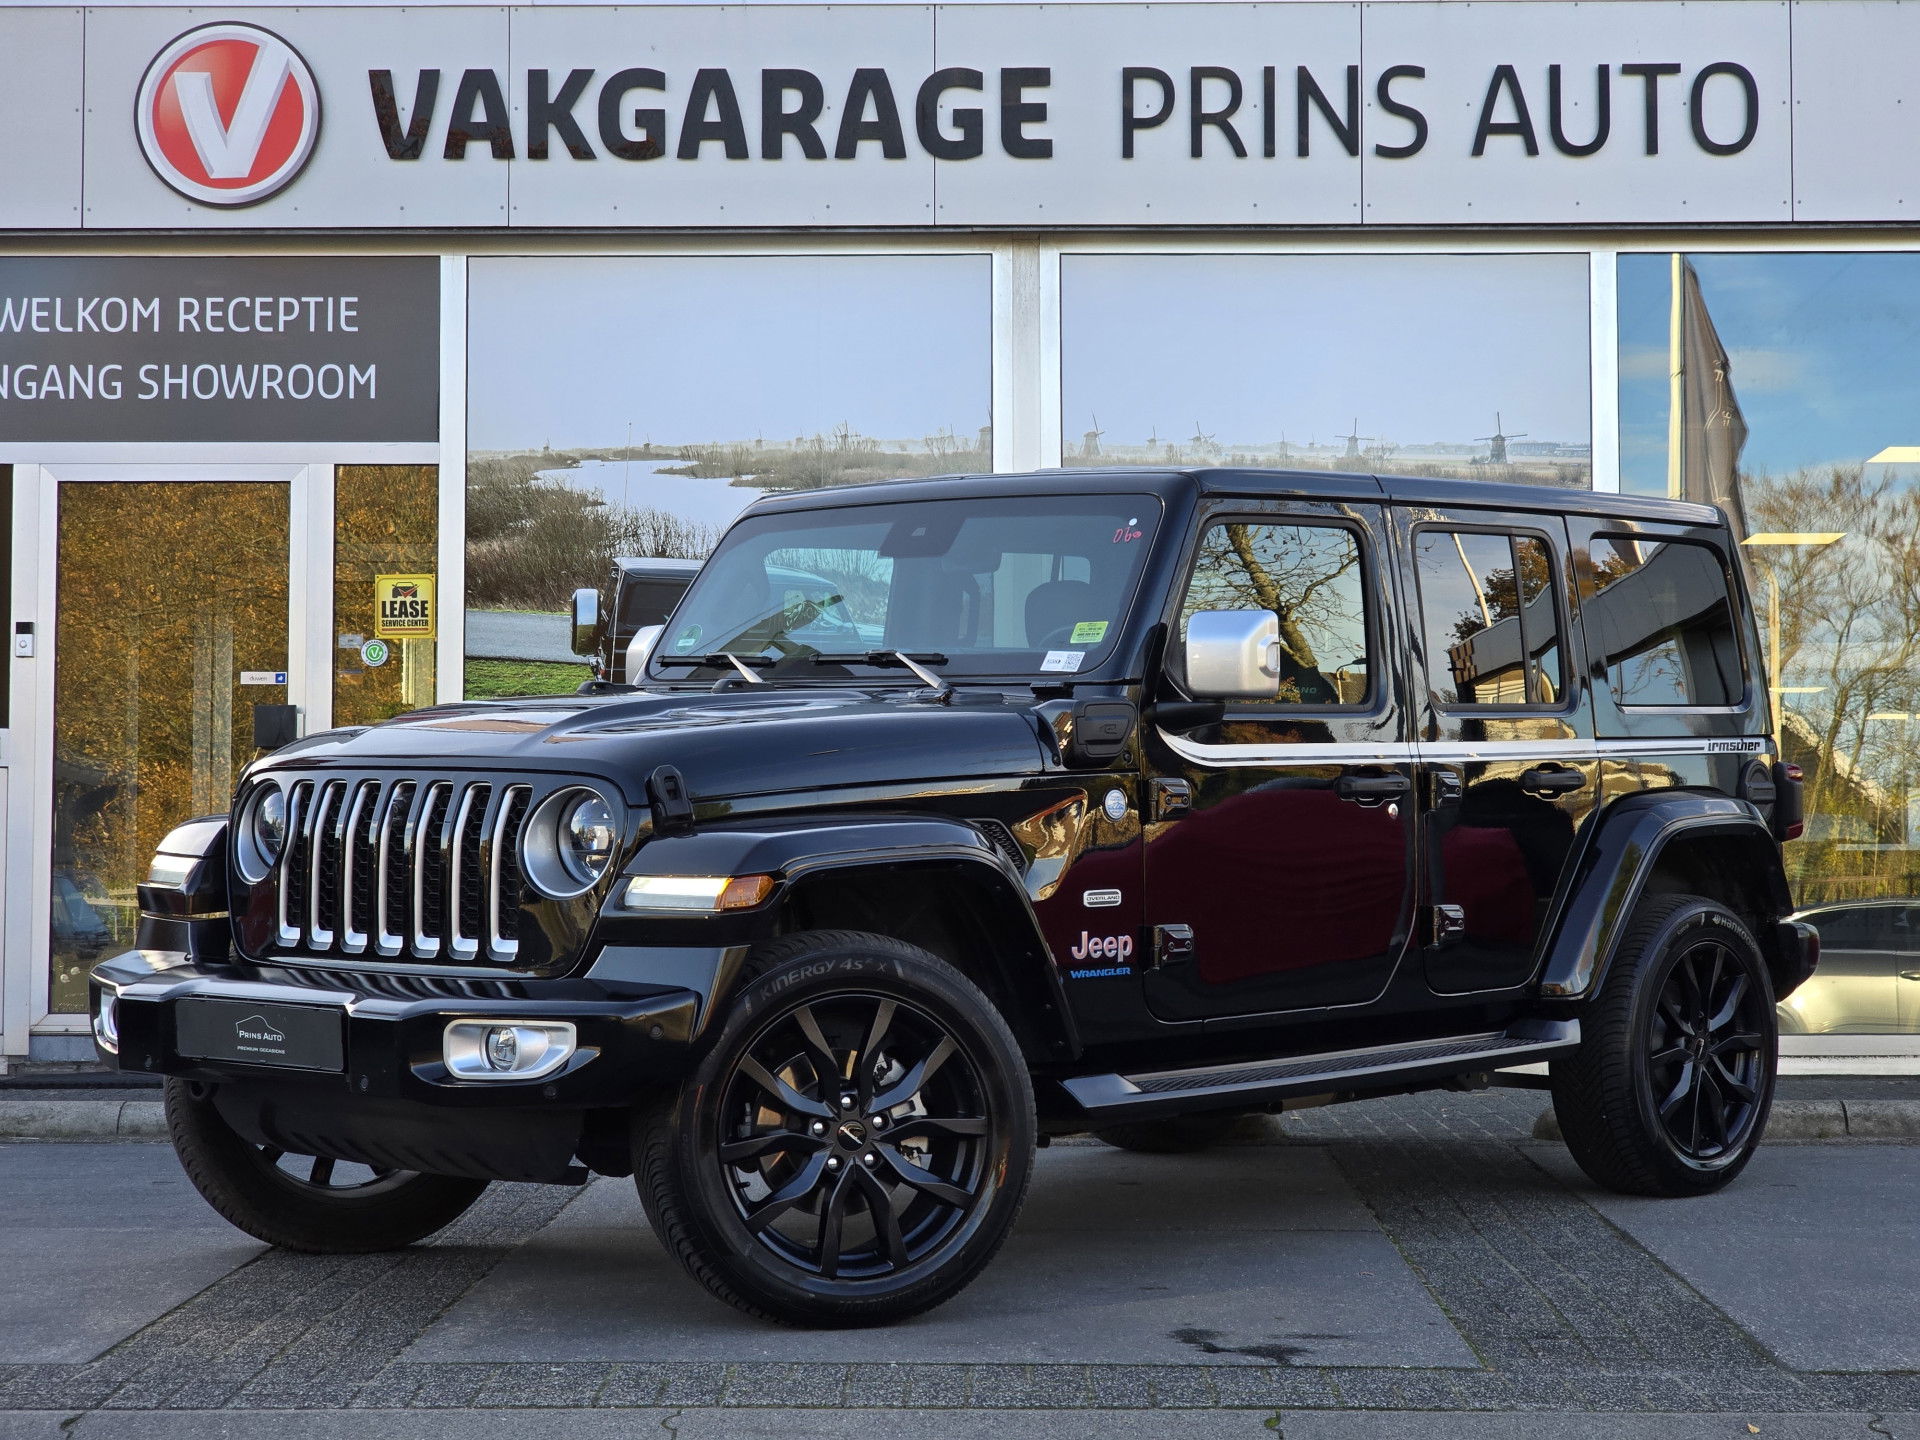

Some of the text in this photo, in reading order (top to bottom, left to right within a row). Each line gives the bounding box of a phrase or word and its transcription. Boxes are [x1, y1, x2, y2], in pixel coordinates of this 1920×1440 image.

[368, 61, 1760, 161] VAKGARAGE PRINS AUTO
[0, 297, 359, 333] WELKOM RECEPTIE
[138, 364, 376, 400] SHOWROOM
[381, 601, 428, 618] LEASE
[1707, 739, 1760, 751] irmscher
[1071, 931, 1133, 962] Jeep
[1070, 967, 1131, 979] WRANGLER
[239, 1031, 282, 1041] PRINS AUTO
